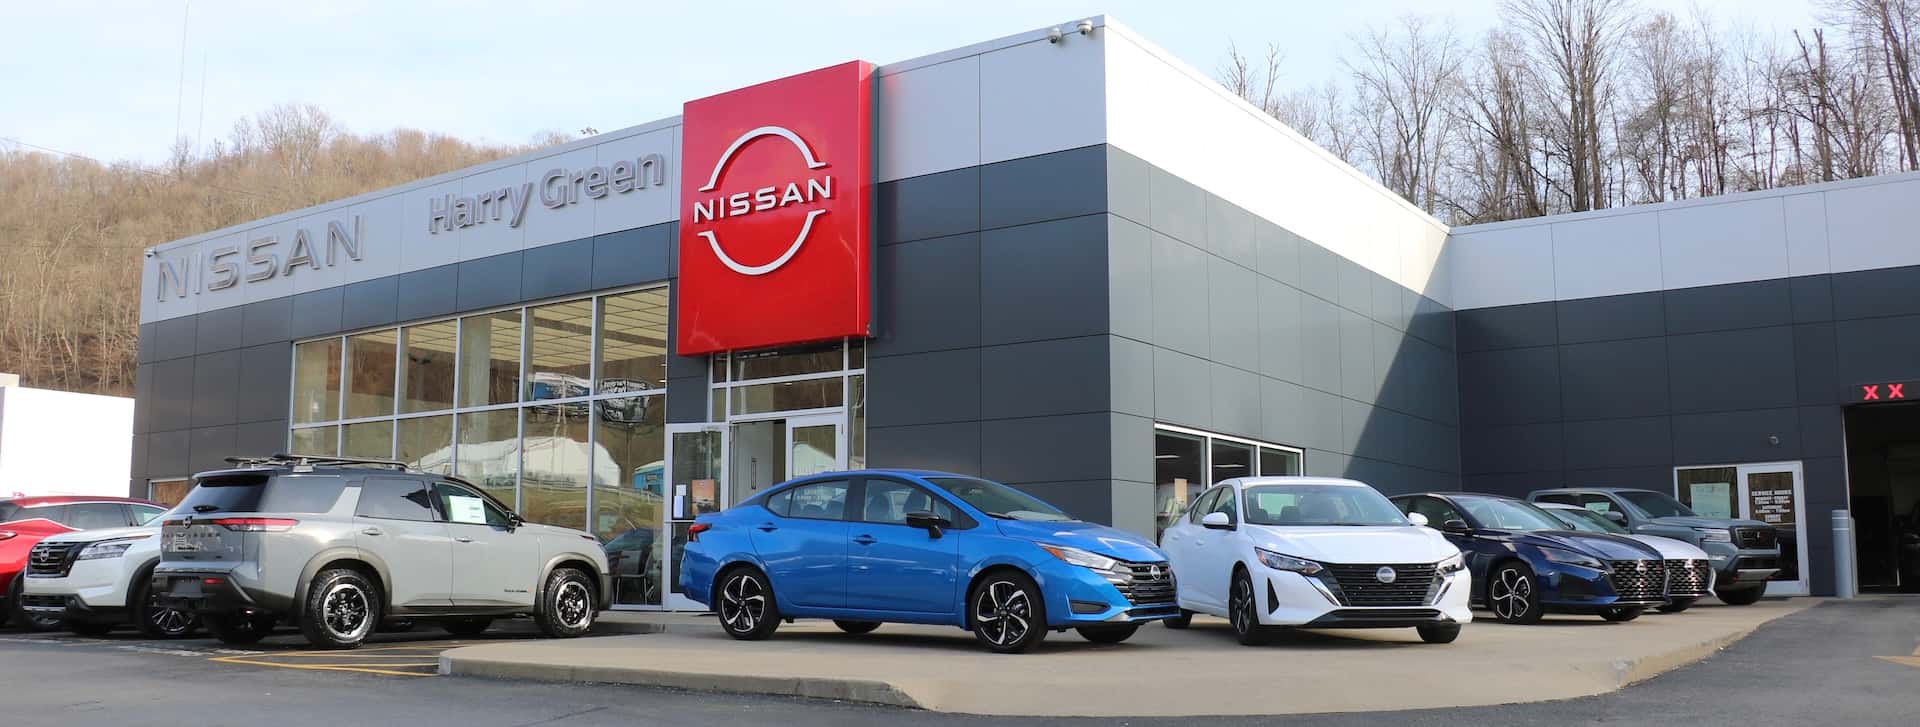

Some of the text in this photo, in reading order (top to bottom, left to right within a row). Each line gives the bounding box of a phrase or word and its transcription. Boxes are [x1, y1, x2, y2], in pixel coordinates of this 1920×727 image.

[428, 152, 665, 234] Harry Green
[693, 175, 832, 224] NISSAN
[157, 215, 365, 303] NISSAN
